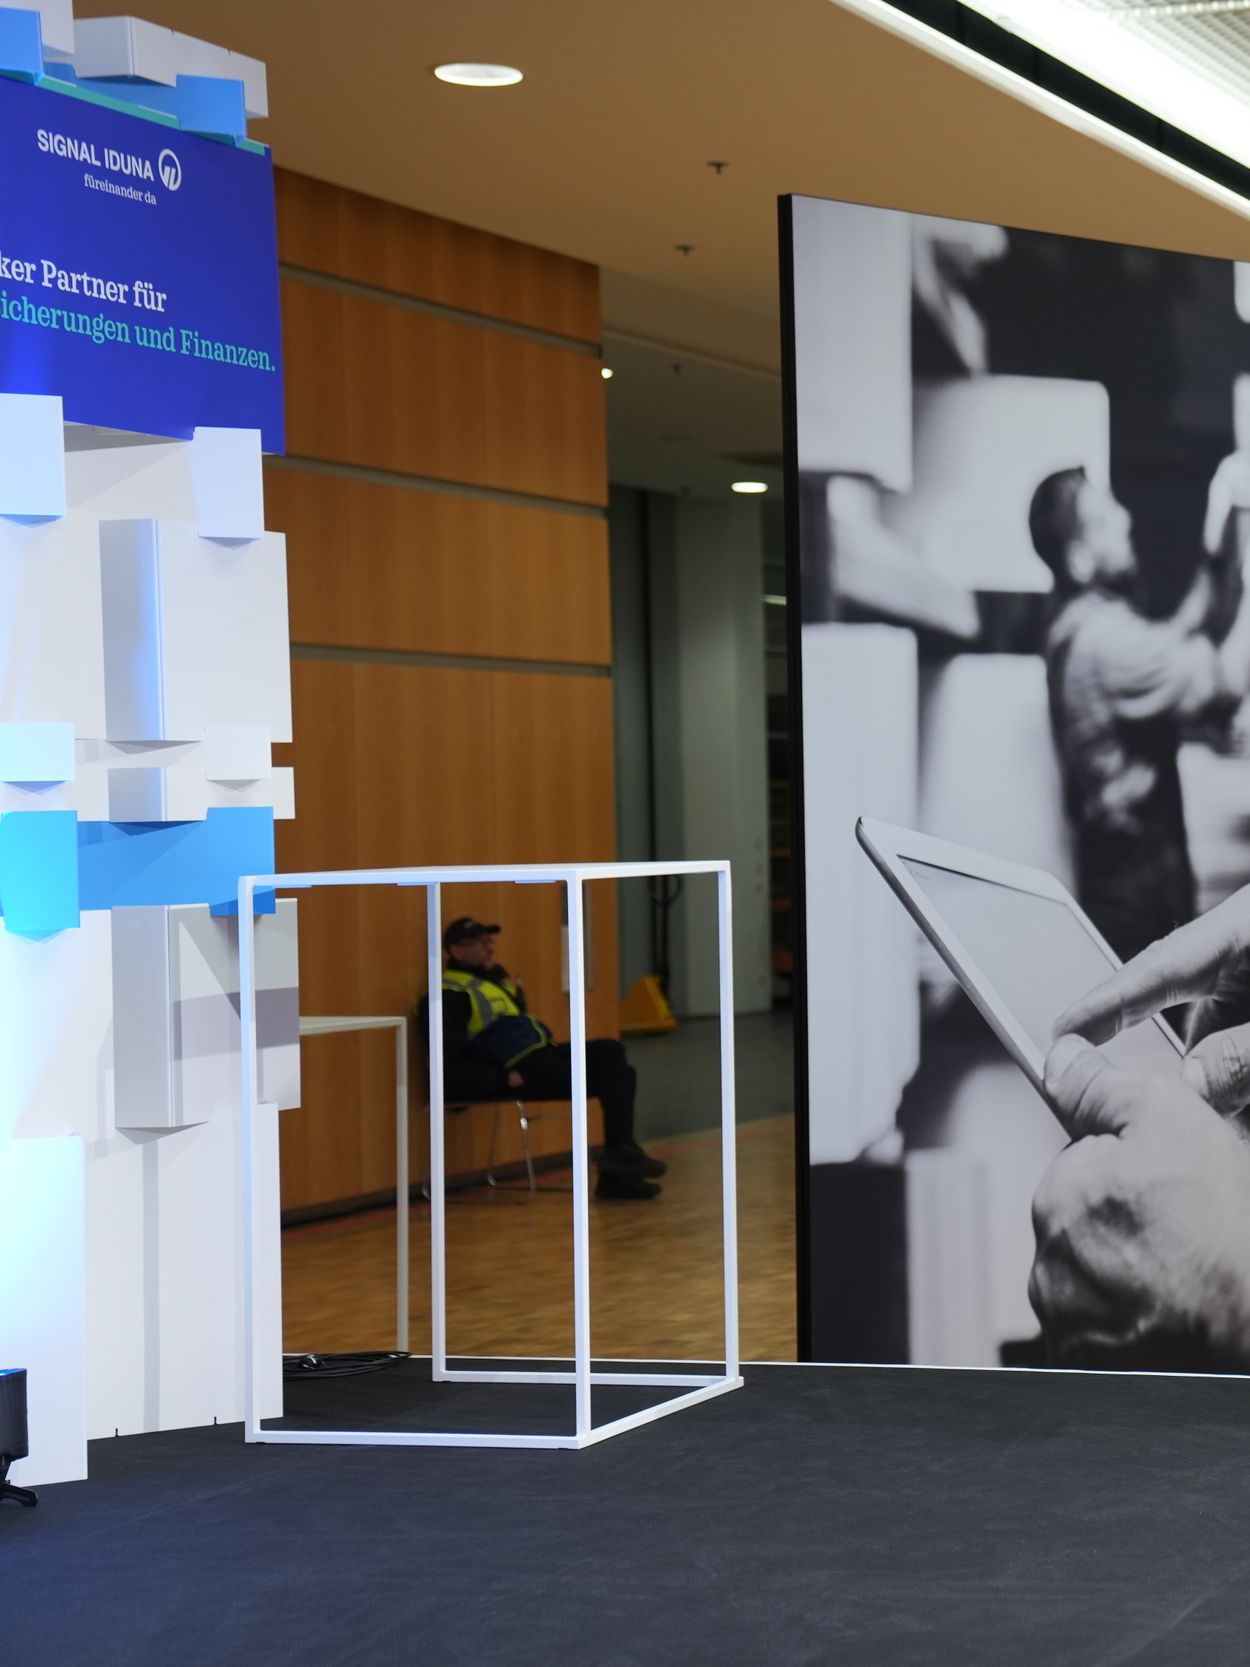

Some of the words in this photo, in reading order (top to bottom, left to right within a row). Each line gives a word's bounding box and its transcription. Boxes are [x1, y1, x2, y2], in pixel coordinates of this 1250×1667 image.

[37, 129, 101, 167] SIGNAL
[104, 148, 154, 181] IDUNA
[84, 173, 143, 202] füreinander
[145, 191, 157, 205] da
[40, 259, 128, 304] Partner
[133, 280, 167, 312] für
[0, 290, 130, 344] icherungen
[134, 326, 176, 352] und
[180, 329, 275, 372] Finanzen.
